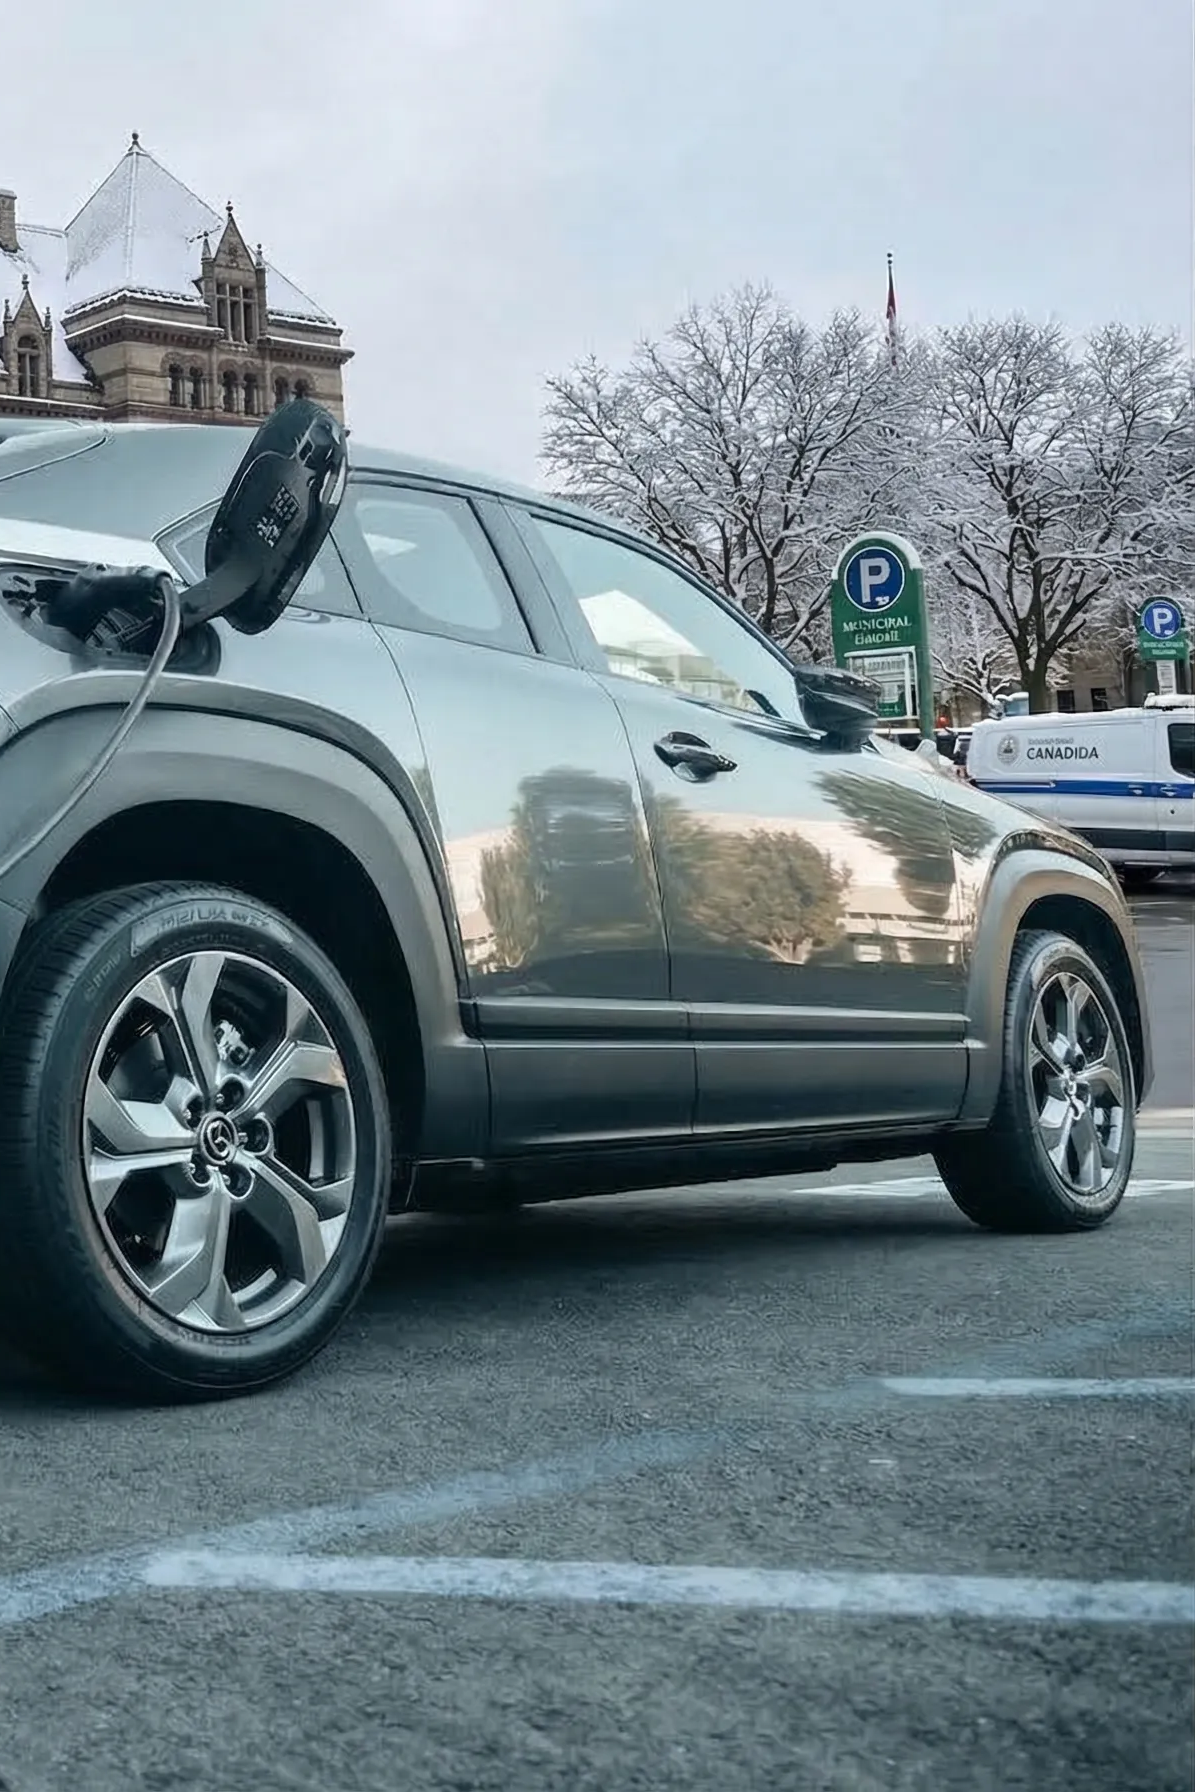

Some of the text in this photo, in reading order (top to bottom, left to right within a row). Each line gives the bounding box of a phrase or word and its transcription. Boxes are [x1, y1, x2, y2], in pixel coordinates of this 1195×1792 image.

[859, 557, 891, 604] P
[1152, 607, 1173, 634] P
[1026, 745, 1099, 760] CANADIDA
